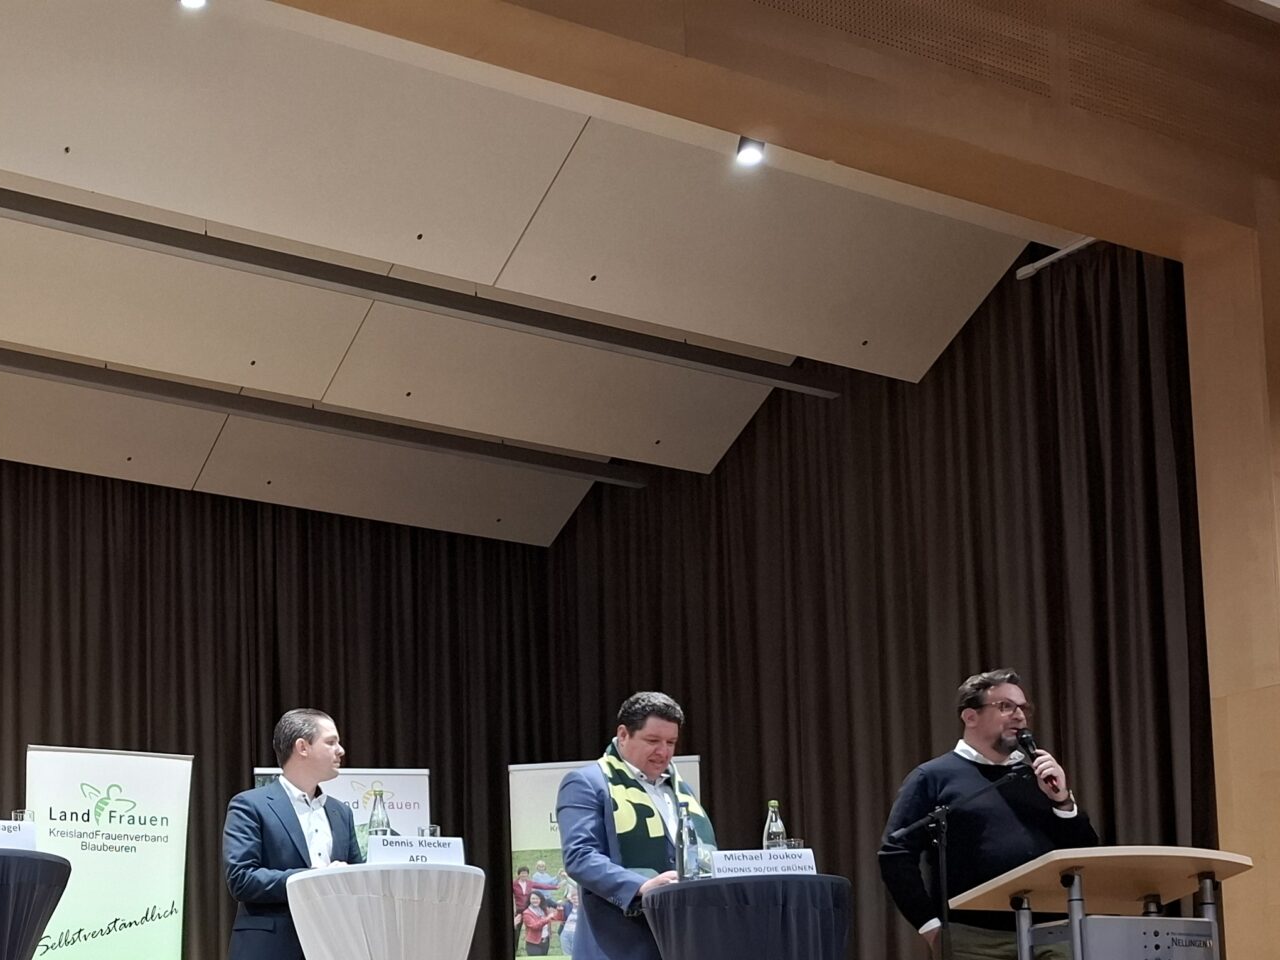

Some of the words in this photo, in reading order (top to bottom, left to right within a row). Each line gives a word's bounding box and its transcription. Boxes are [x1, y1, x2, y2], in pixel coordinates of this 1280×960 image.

[49, 806, 91, 822] Land
[108, 810, 169, 826] Frauen
[48, 827, 169, 843] KreislandFrauenverband
[80, 840, 137, 853] Blaubeuren
[382, 838, 414, 848] Dennis
[418, 839, 452, 848] Klecker
[724, 853, 763, 861] Michael
[768, 851, 803, 861] Joukov
[781, 864, 814, 872] GRÜNEN
[37, 901, 178, 956] Selbstverständlich
